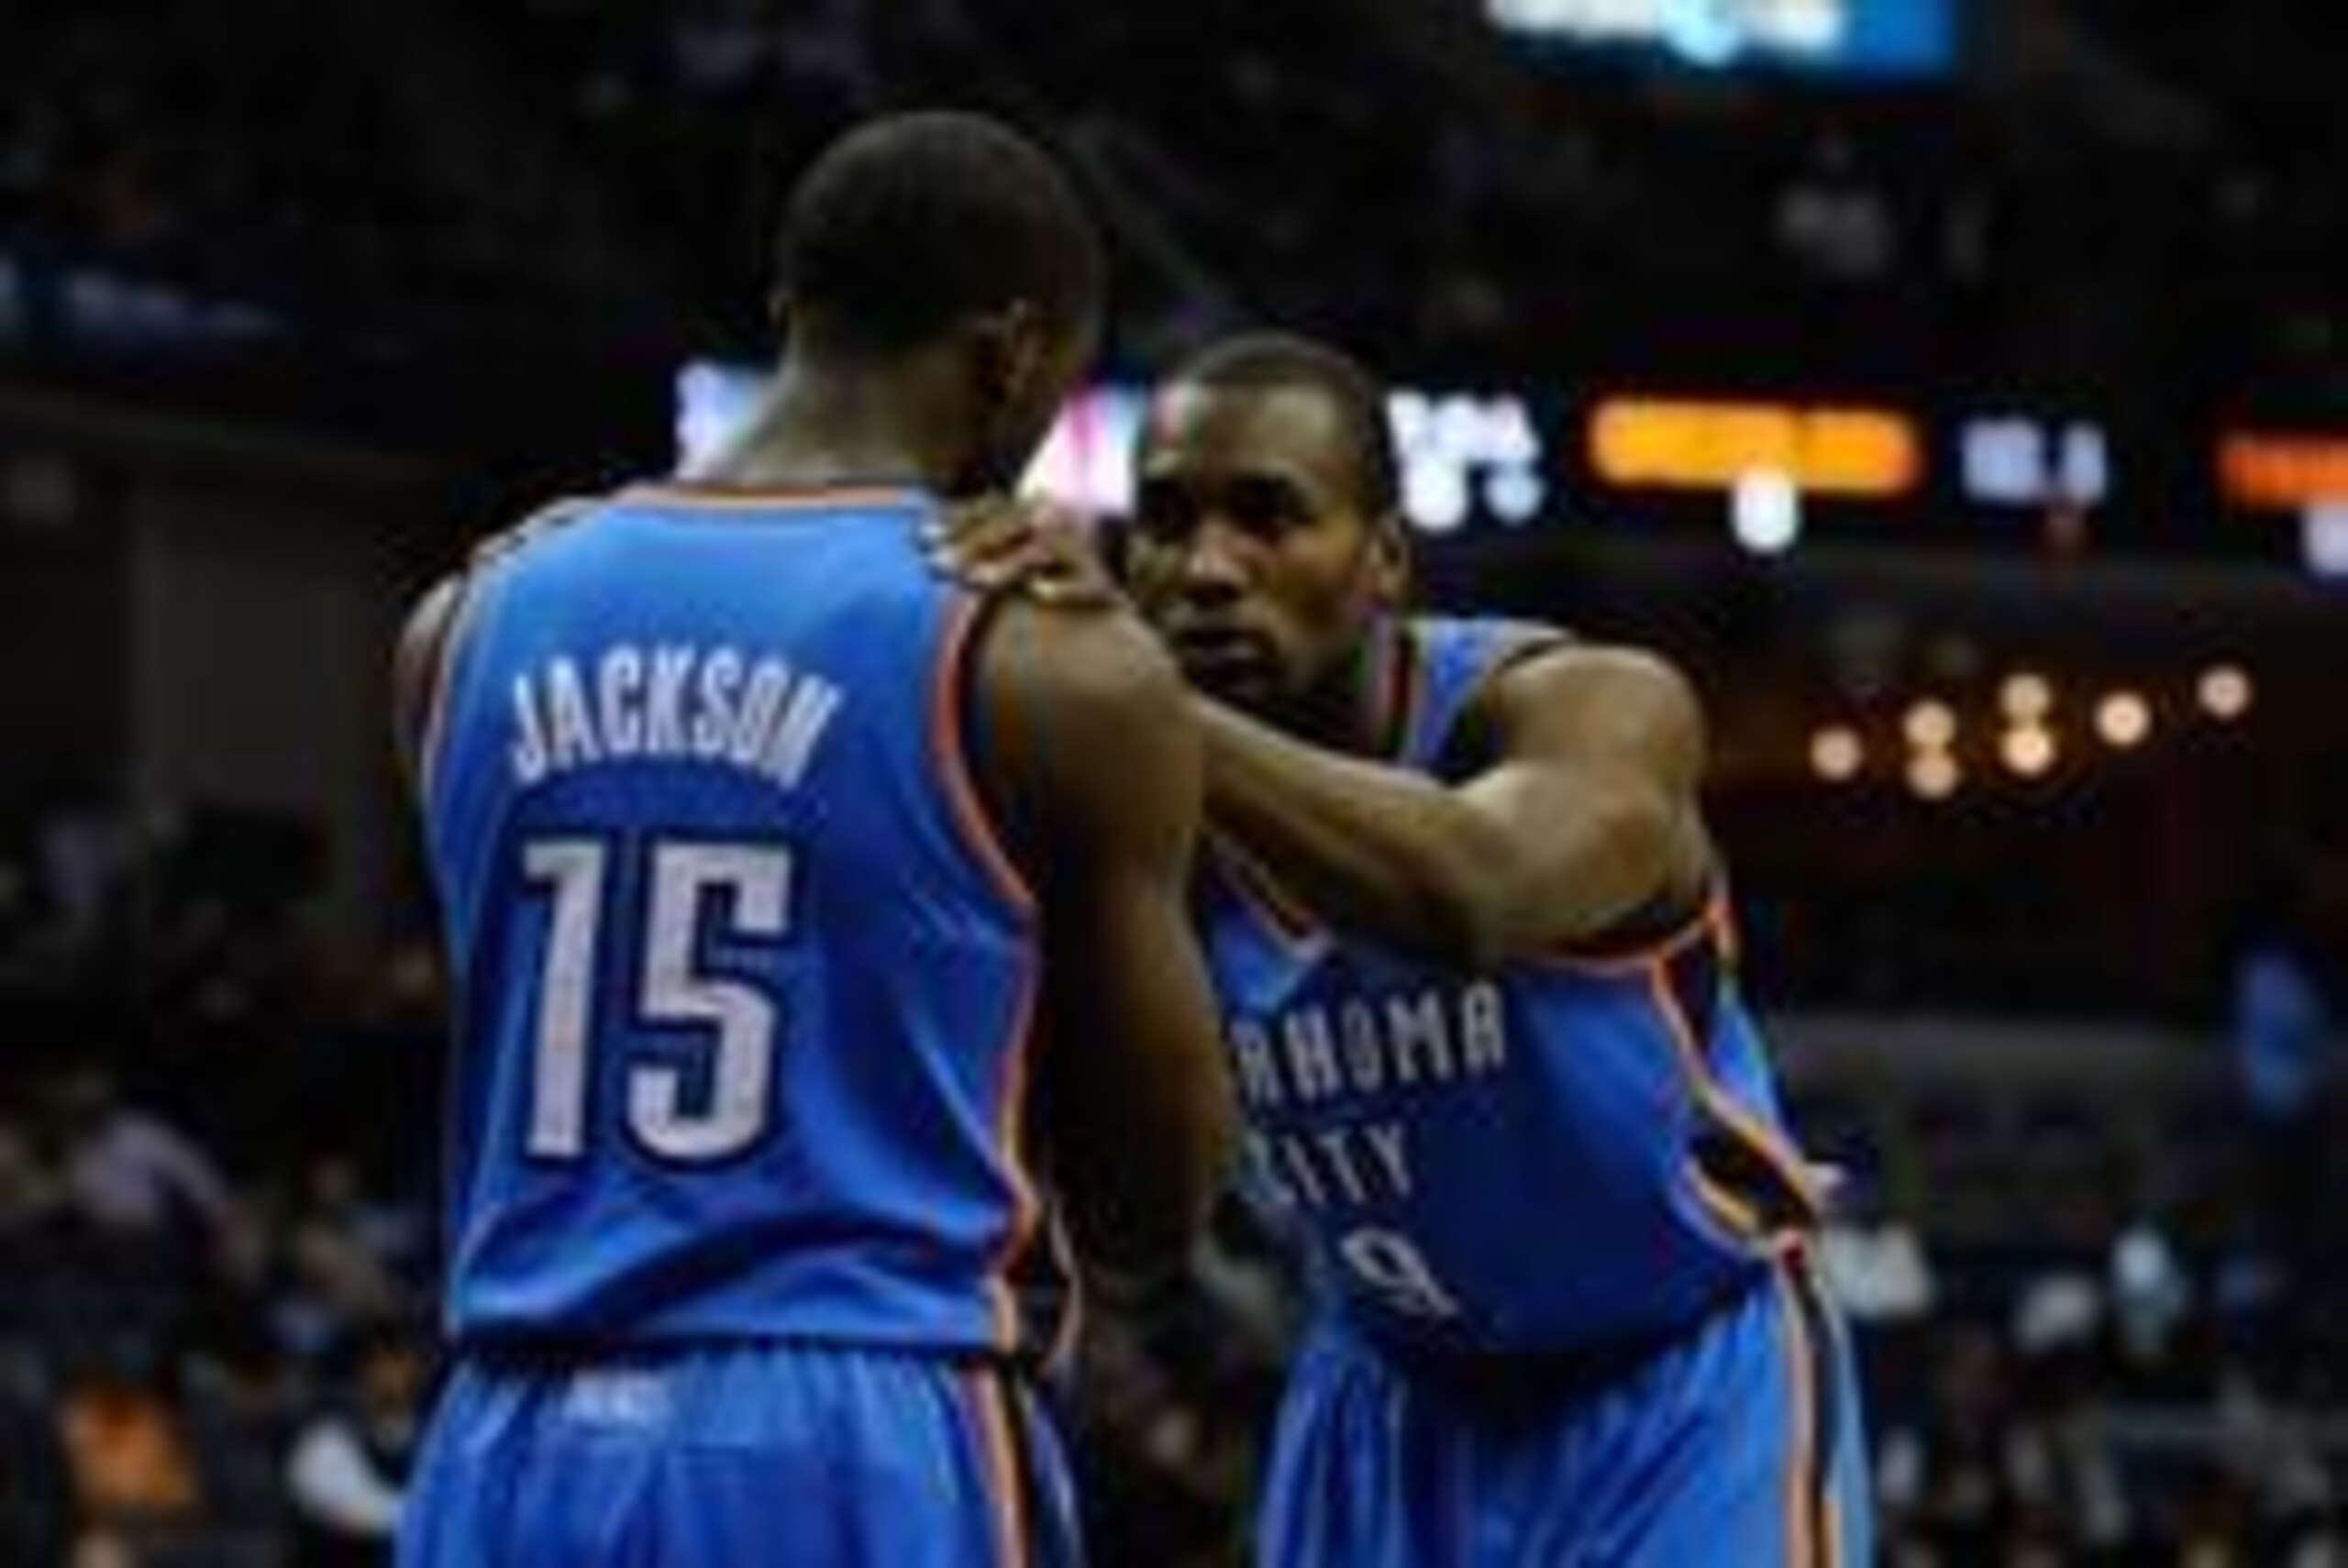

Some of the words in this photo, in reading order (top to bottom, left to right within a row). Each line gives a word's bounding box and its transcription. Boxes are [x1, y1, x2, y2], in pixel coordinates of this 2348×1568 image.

[512, 642, 842, 788] JACKSON
[524, 841, 791, 1156] 15
[1341, 1229, 1458, 1317] 9
